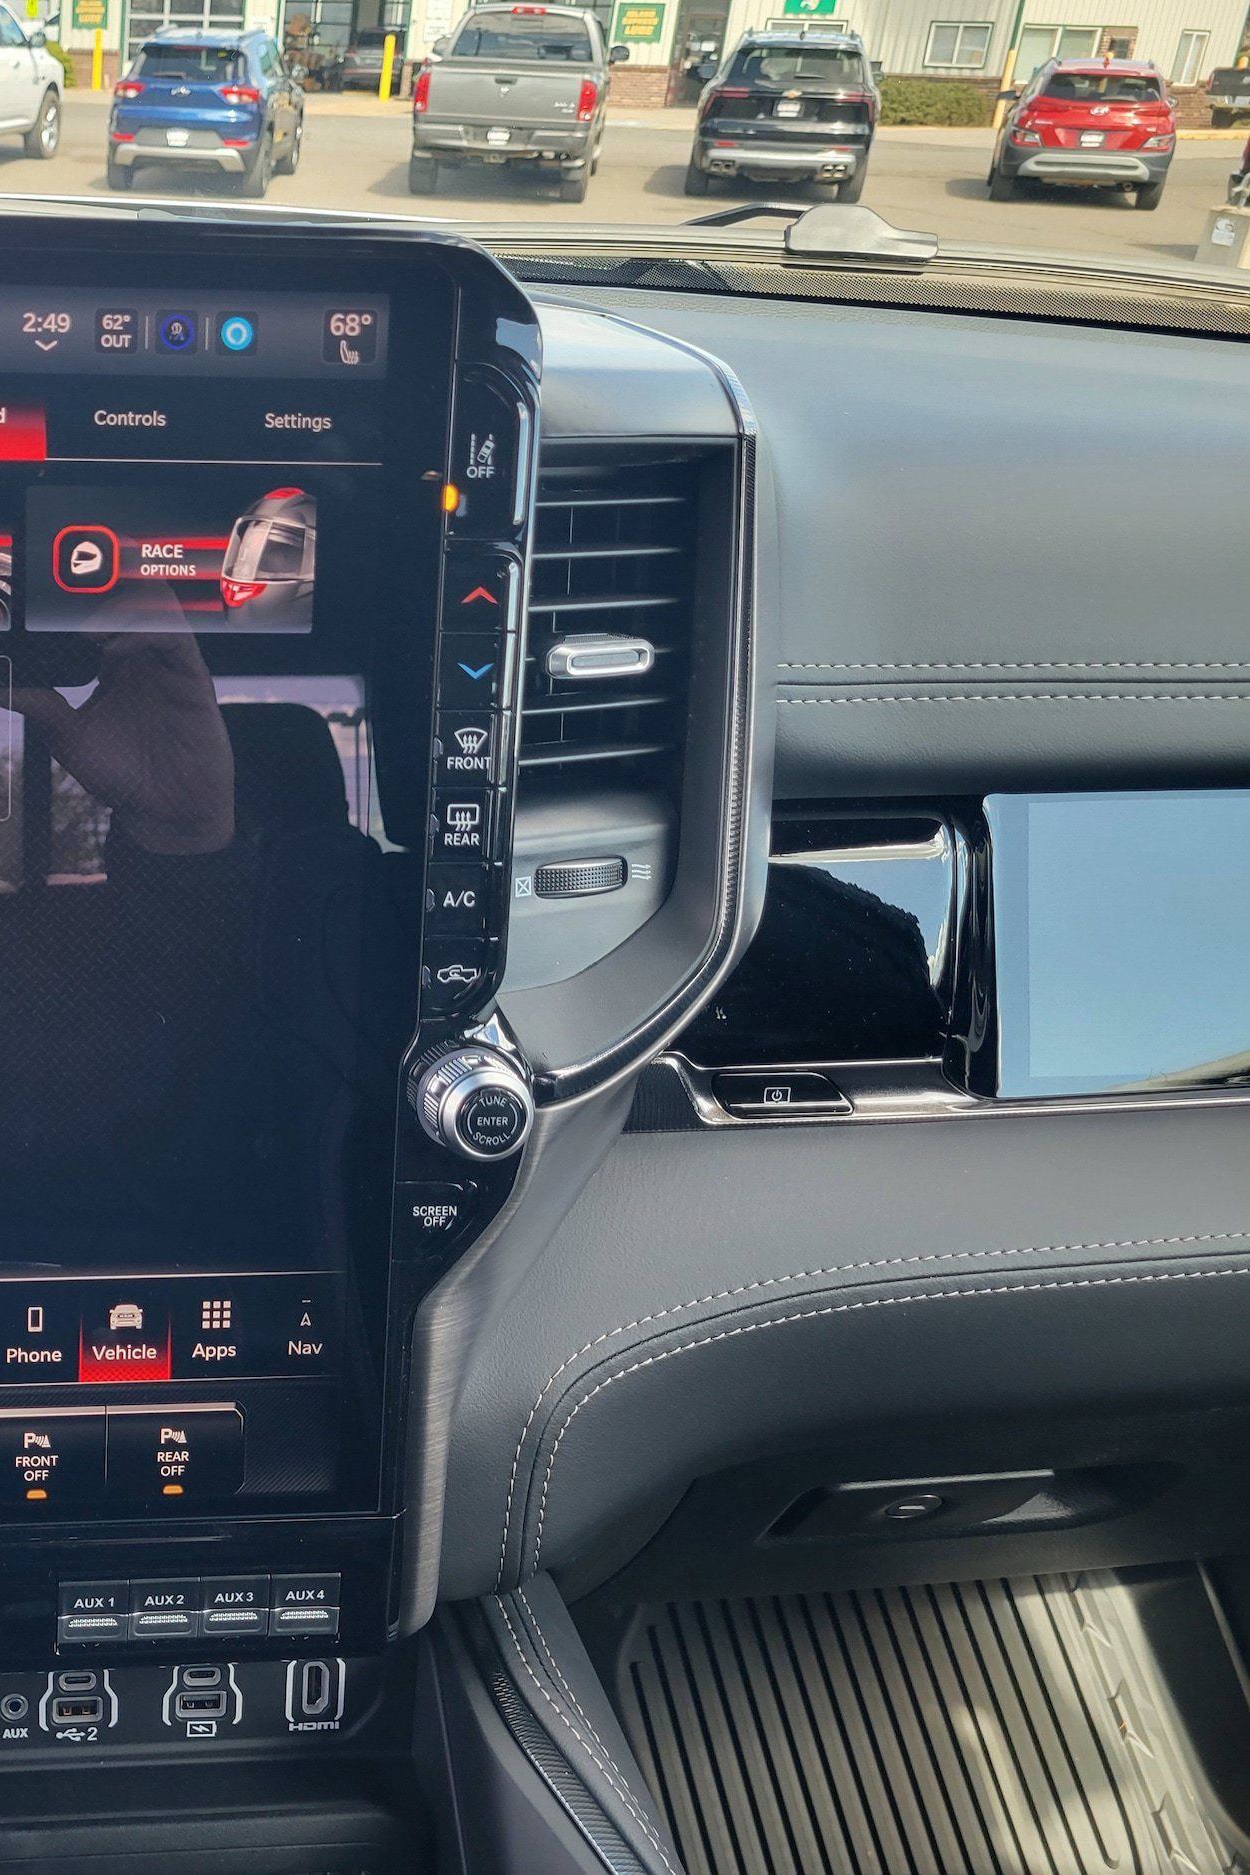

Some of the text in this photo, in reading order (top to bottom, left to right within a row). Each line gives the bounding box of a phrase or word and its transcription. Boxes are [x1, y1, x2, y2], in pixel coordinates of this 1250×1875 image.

[22, 312, 71, 333] 2:49
[102, 313, 131, 330] 62°
[329, 313, 372, 337] 68°
[100, 334, 132, 348] OUT
[94, 410, 166, 428] Controls
[265, 413, 332, 432] Settings
[466, 466, 495, 479] OFF
[141, 544, 184, 558] RACE
[140, 564, 196, 577] OPTIONS
[447, 757, 492, 770] FRONT
[444, 833, 480, 846] REAR
[443, 891, 476, 908] A/C
[479, 1096, 508, 1108] TUNE
[477, 1116, 508, 1126] ENTER
[472, 1131, 512, 1146] SCROLL
[412, 1205, 457, 1216] SCREEN
[423, 1216, 446, 1227] OFF
[91, 1345, 157, 1361] Vehicle
[192, 1343, 237, 1361] Apps
[288, 1341, 323, 1355] Nav
[6, 1348, 62, 1363] Phone
[15, 1455, 58, 1467] FRONT
[157, 1451, 189, 1463] REAR
[24, 1470, 49, 1481] OFF
[160, 1465, 185, 1477] OFF
[144, 1594, 184, 1606] AUX 2
[214, 1592, 254, 1603] AUX 3
[285, 1589, 325, 1601] AUX 4
[74, 1597, 115, 1609] AUX 1
[288, 1721, 340, 1731] HDMI
[2, 1727, 29, 1739] AUX
[87, 1727, 98, 1741] 2
